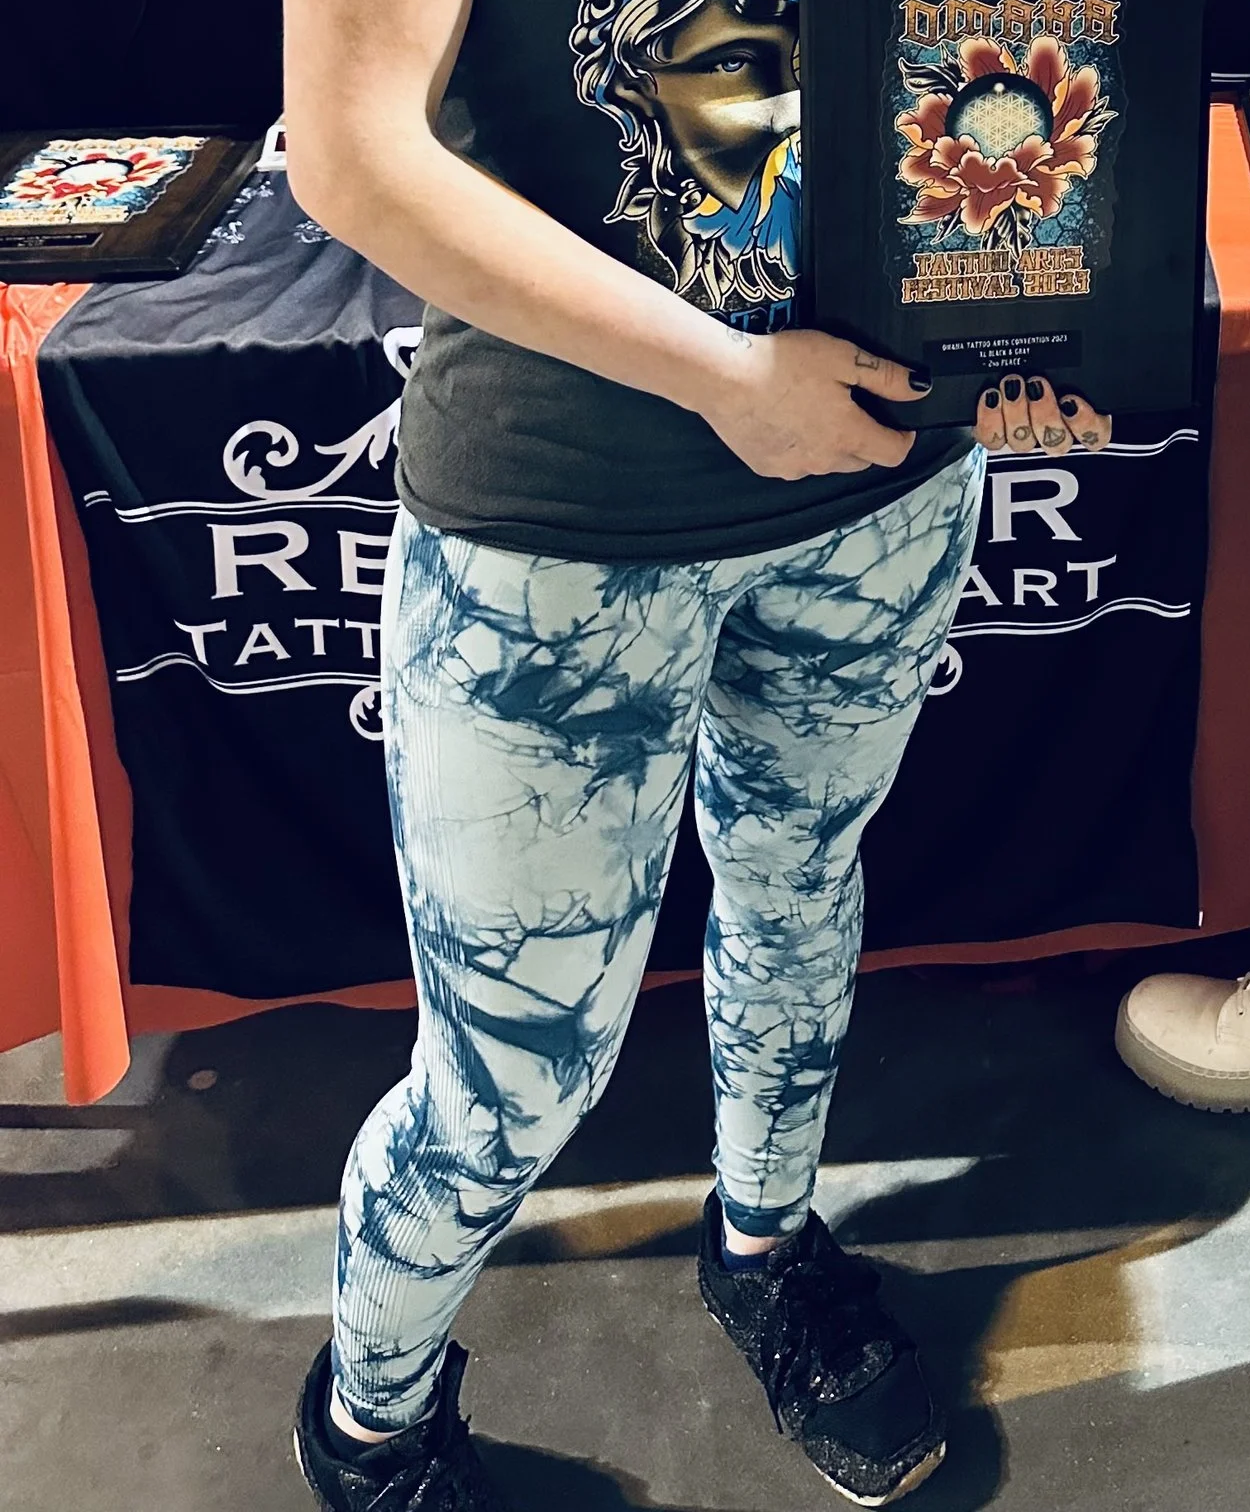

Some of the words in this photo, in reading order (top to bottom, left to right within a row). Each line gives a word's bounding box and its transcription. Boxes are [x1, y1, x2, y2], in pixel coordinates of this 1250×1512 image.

[914, 250, 1011, 277] TATTOO
[1016, 246, 1085, 273] ARTS
[902, 273, 1020, 304] FESTIVAL
[1023, 269, 1092, 296] 2023
[967, 340, 991, 349] TATTOO
[993, 339, 1010, 348] ARTS
[1011, 337, 1050, 346] CONVENTION
[1051, 334, 1068, 343] 2023
[988, 349, 1007, 357] BLACK
[1001, 358, 1021, 366] PLACE
[958, 554, 1117, 607] ART
